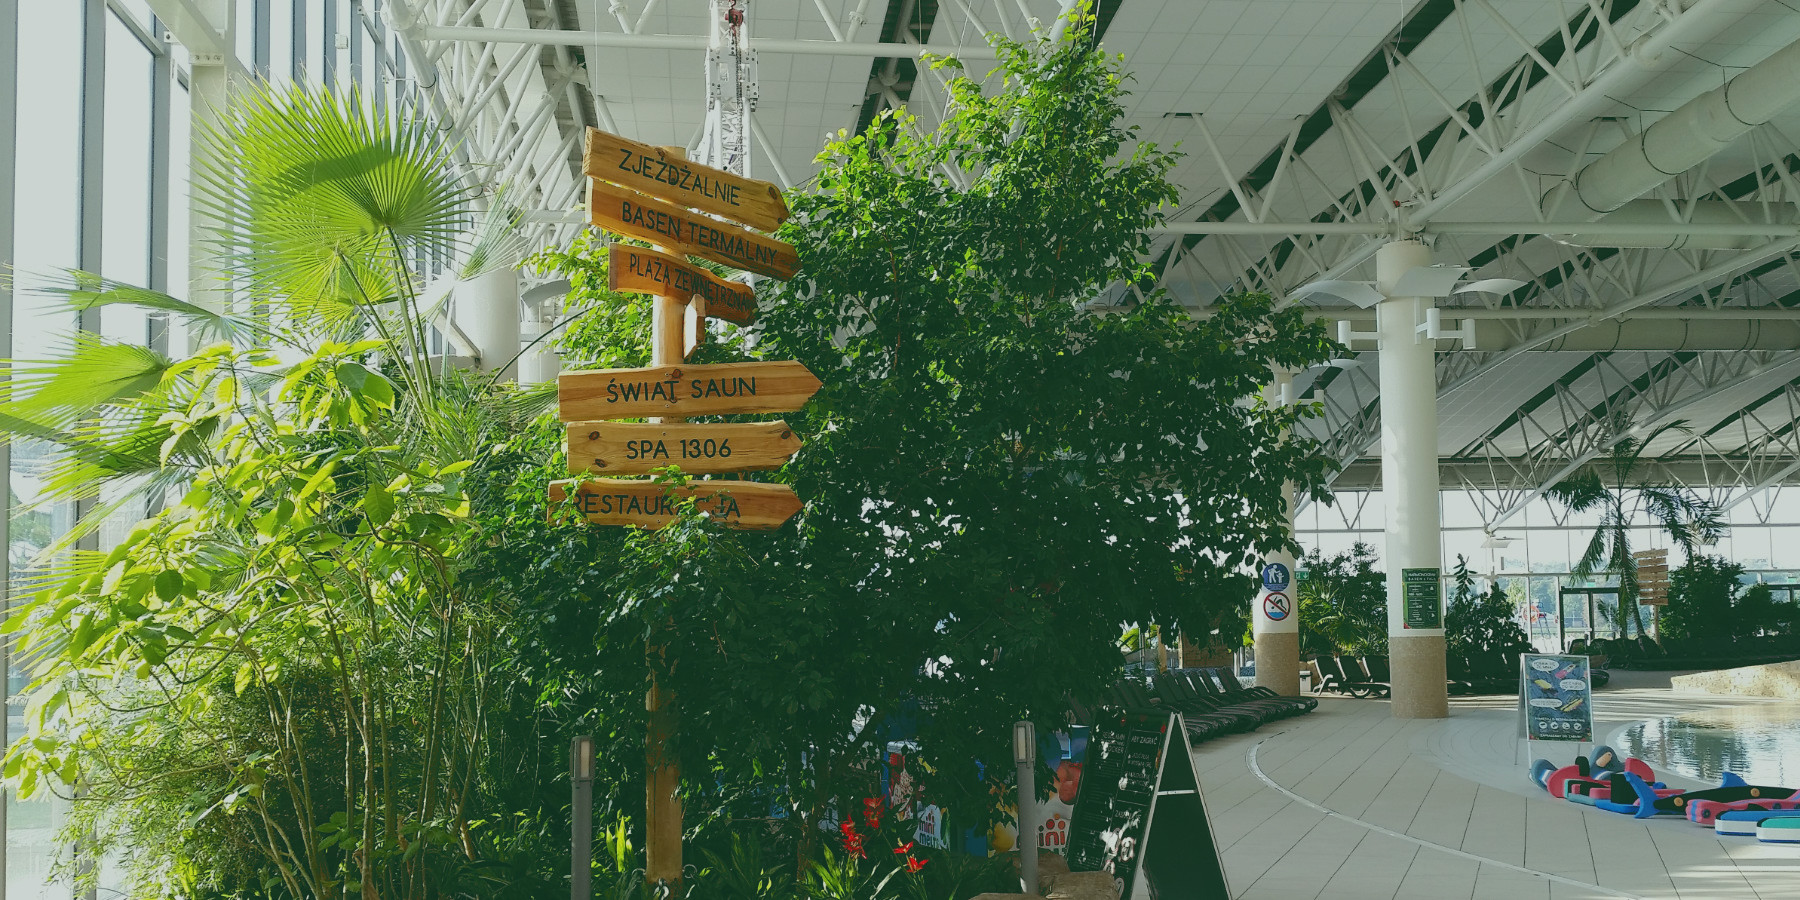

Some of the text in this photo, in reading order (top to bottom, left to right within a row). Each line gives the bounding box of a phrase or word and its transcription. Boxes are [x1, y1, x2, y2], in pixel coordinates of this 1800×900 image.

[618, 148, 741, 207] ZJEŻDŻALNIE
[621, 201, 778, 267] BASEN TERMALNY
[629, 253, 747, 311] PLAŻA ZEWNĘTRZNA
[606, 376, 756, 403] ŚWIAT SAUN
[626, 438, 732, 460] SPA 1306
[572, 493, 741, 519] RESTAURJA
[919, 812, 935, 835] mini
